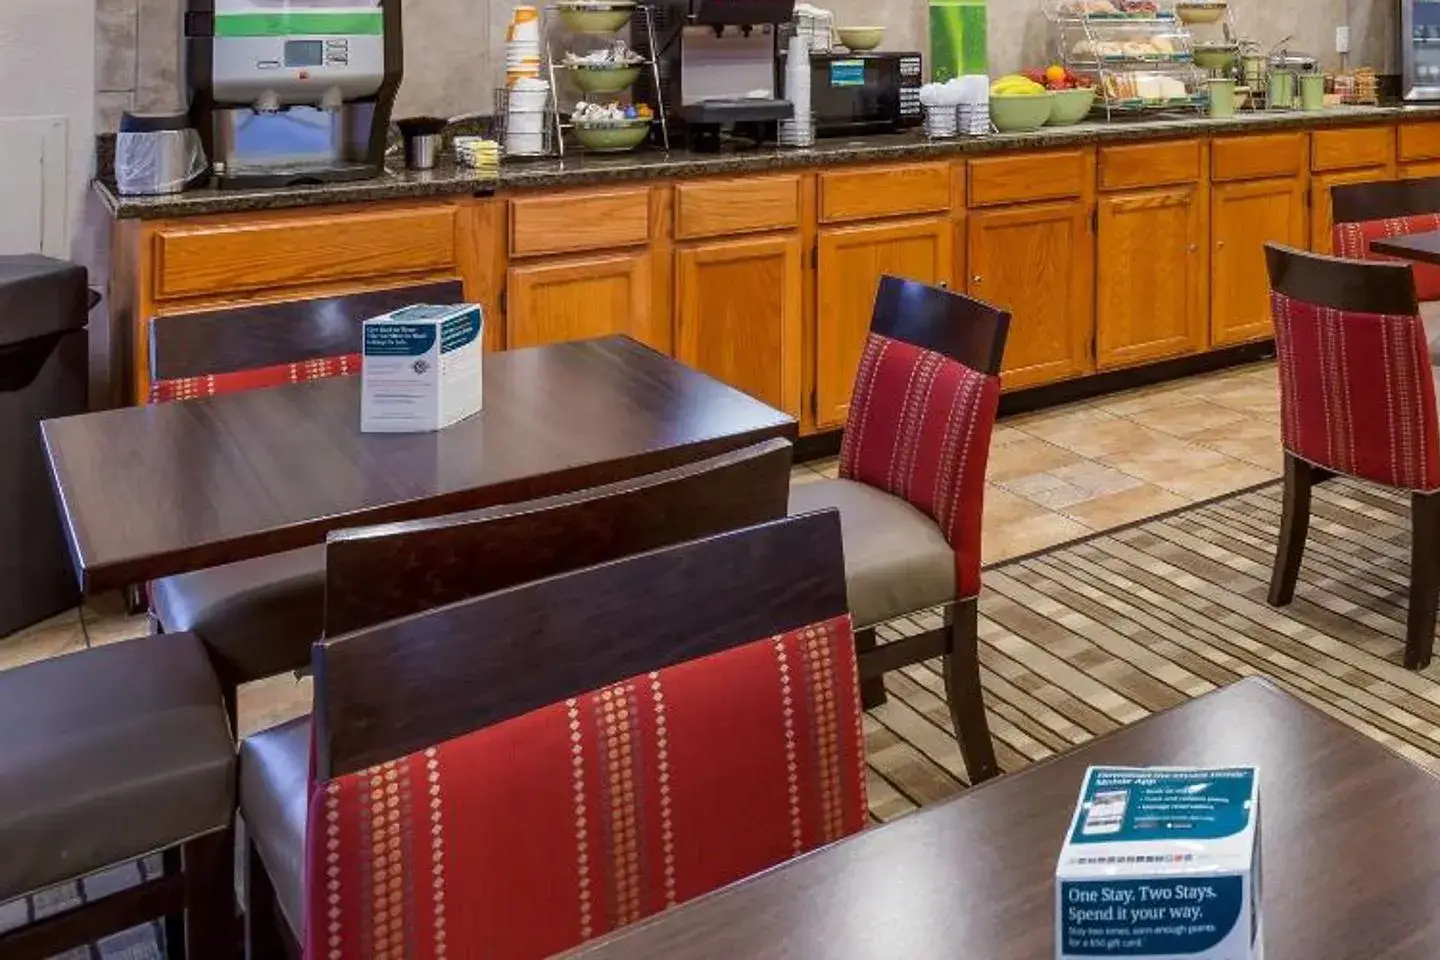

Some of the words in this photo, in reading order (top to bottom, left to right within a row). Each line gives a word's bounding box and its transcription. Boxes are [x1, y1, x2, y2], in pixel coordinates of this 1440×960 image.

[1068, 888, 1098, 902] One
[1101, 887, 1136, 905] Stay.
[1138, 885, 1172, 900] Two
[1174, 884, 1217, 903] Stays.
[1068, 906, 1114, 925] Spend
[1116, 907, 1127, 921] it
[1130, 907, 1166, 925] your
[1168, 906, 1203, 923] way.
